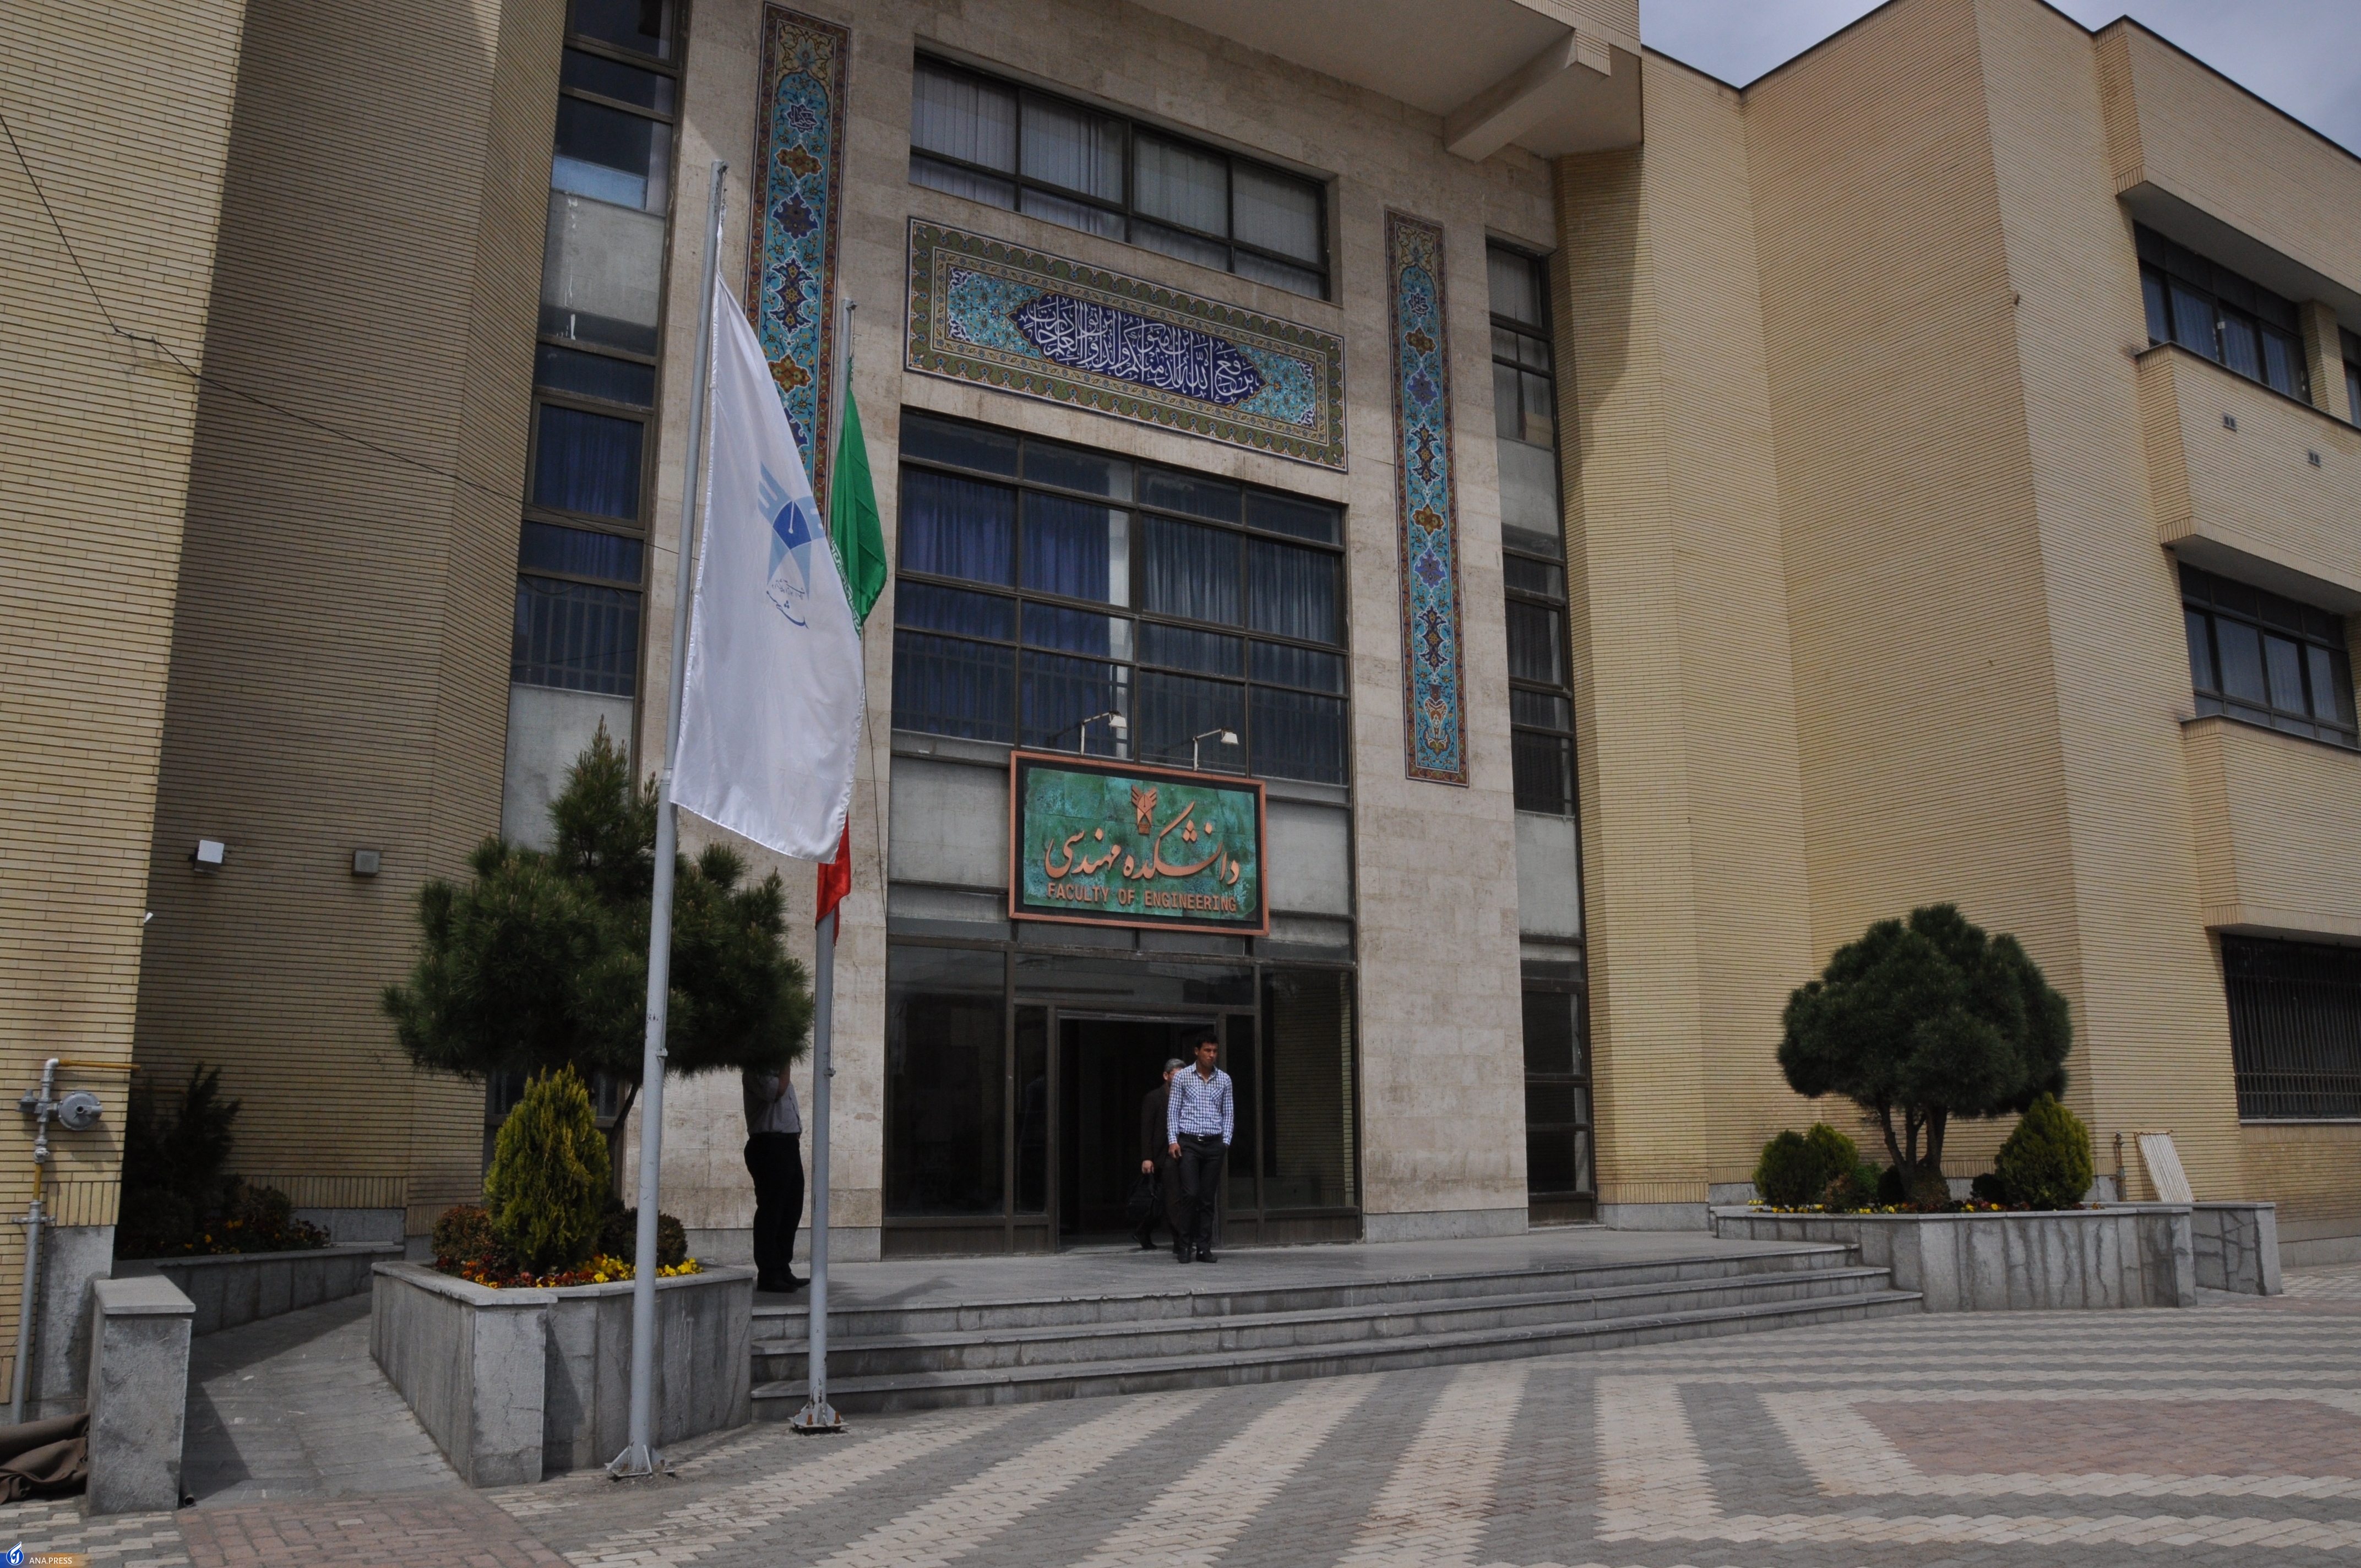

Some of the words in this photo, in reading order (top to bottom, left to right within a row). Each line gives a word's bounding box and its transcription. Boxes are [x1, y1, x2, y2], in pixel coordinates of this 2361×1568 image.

[1045, 827, 1122, 879] مهندسی
[1123, 801, 1240, 885] دانشکده
[1047, 882, 1109, 902] FACULTY
[1118, 888, 1136, 906] OF
[1143, 890, 1237, 912] ENGINEERING
